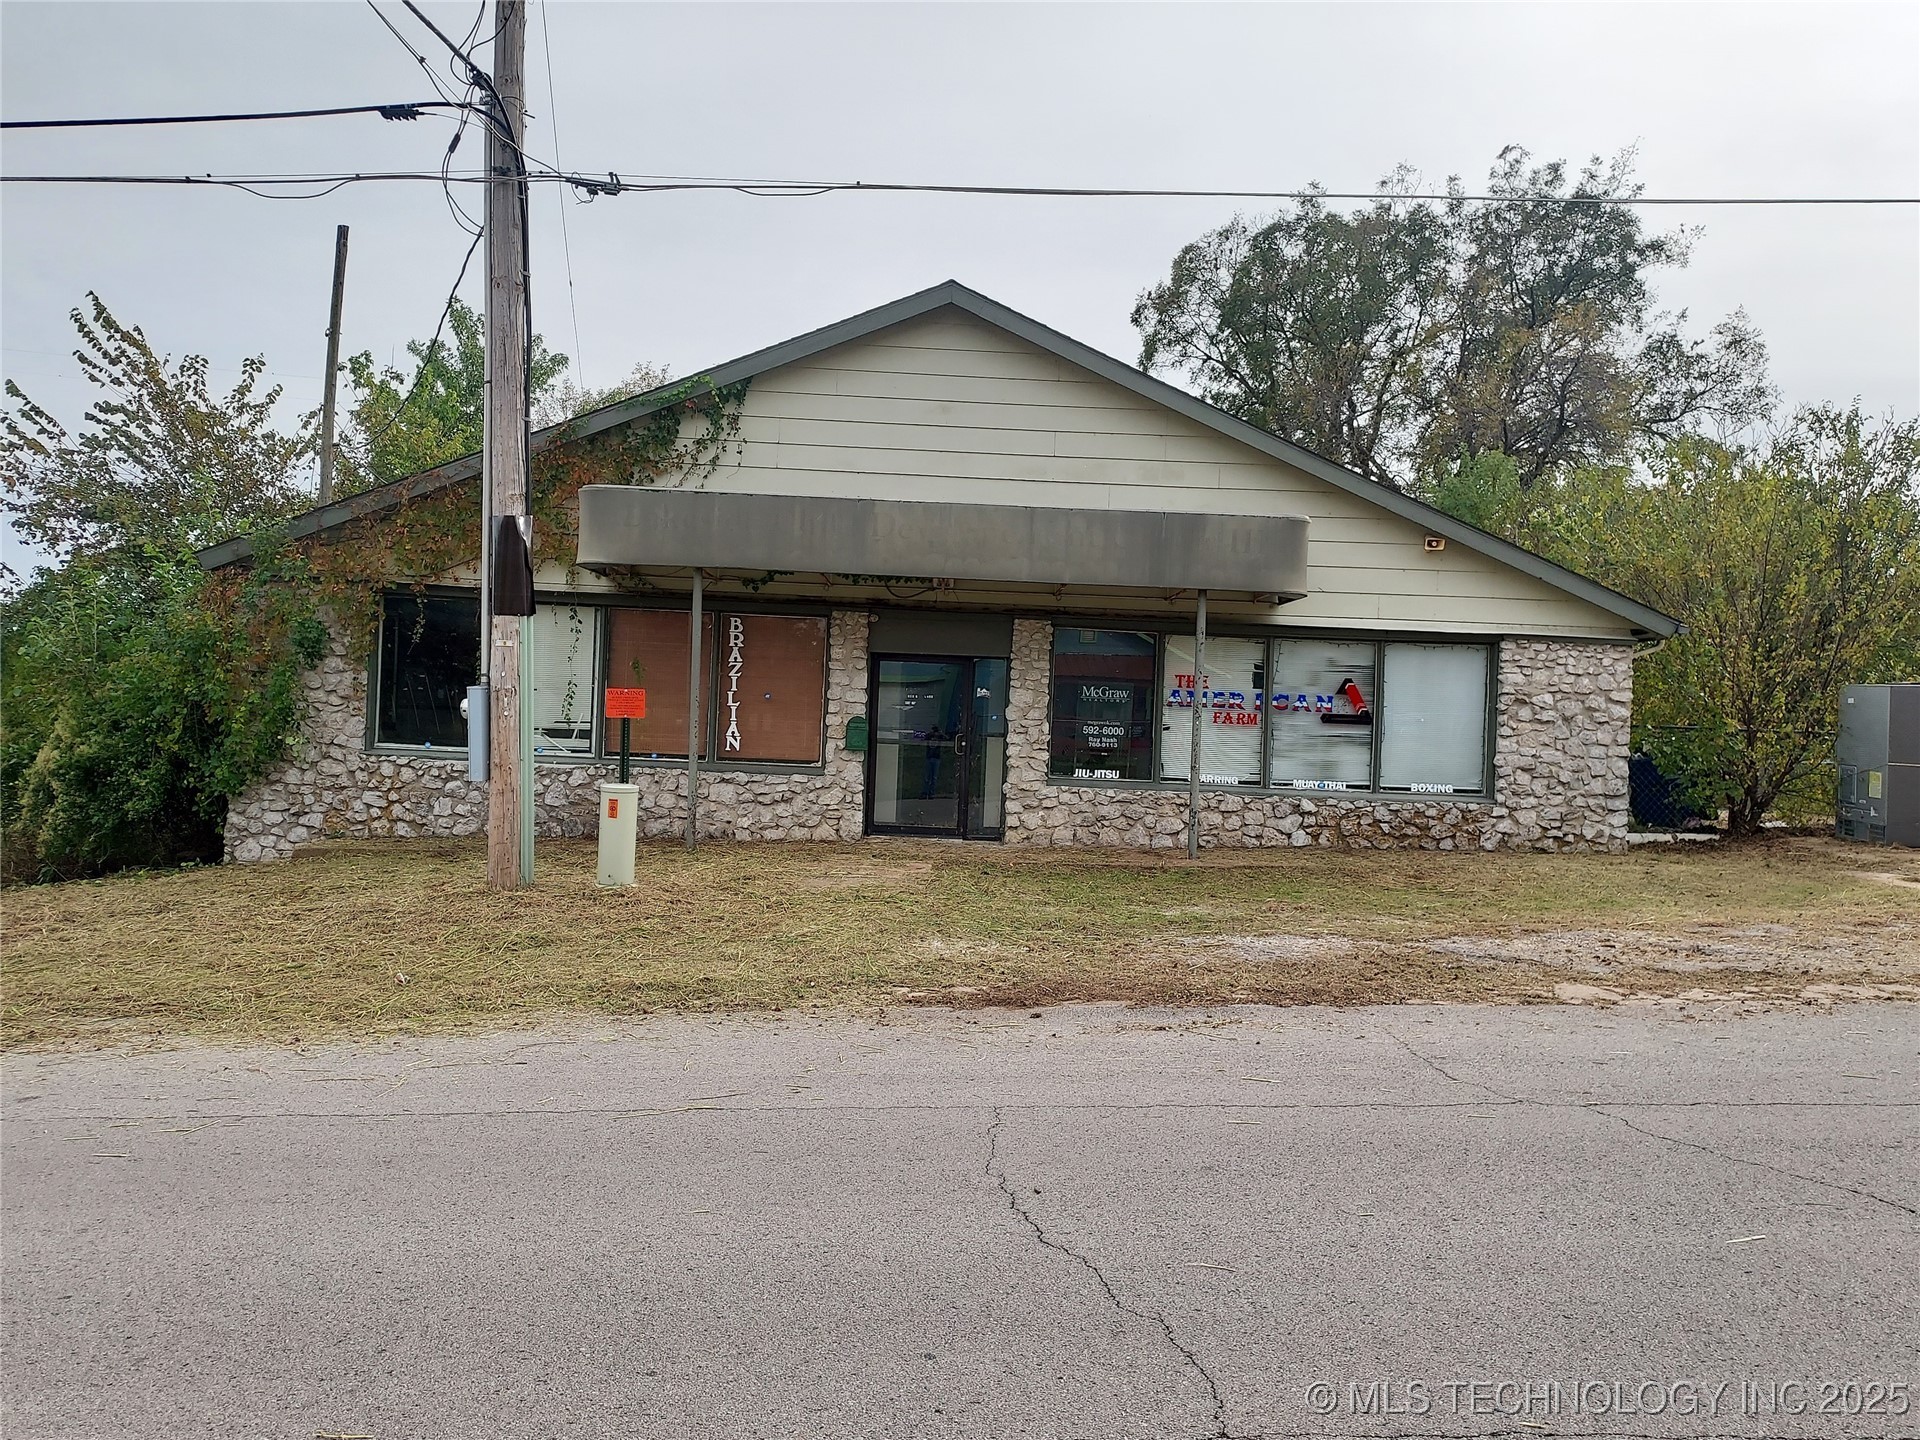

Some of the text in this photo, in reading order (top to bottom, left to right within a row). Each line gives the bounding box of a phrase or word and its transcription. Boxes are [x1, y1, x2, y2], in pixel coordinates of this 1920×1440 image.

[725, 617, 744, 751] BRAZILIAN
[1082, 685, 1130, 698] McGraw
[1212, 711, 1259, 726] FARM
[1082, 726, 1125, 736] 592-6000
[1073, 768, 1120, 779] JIU-JITSU
[1187, 773, 1239, 785] ARRING
[1410, 783, 1454, 793] BOXING
